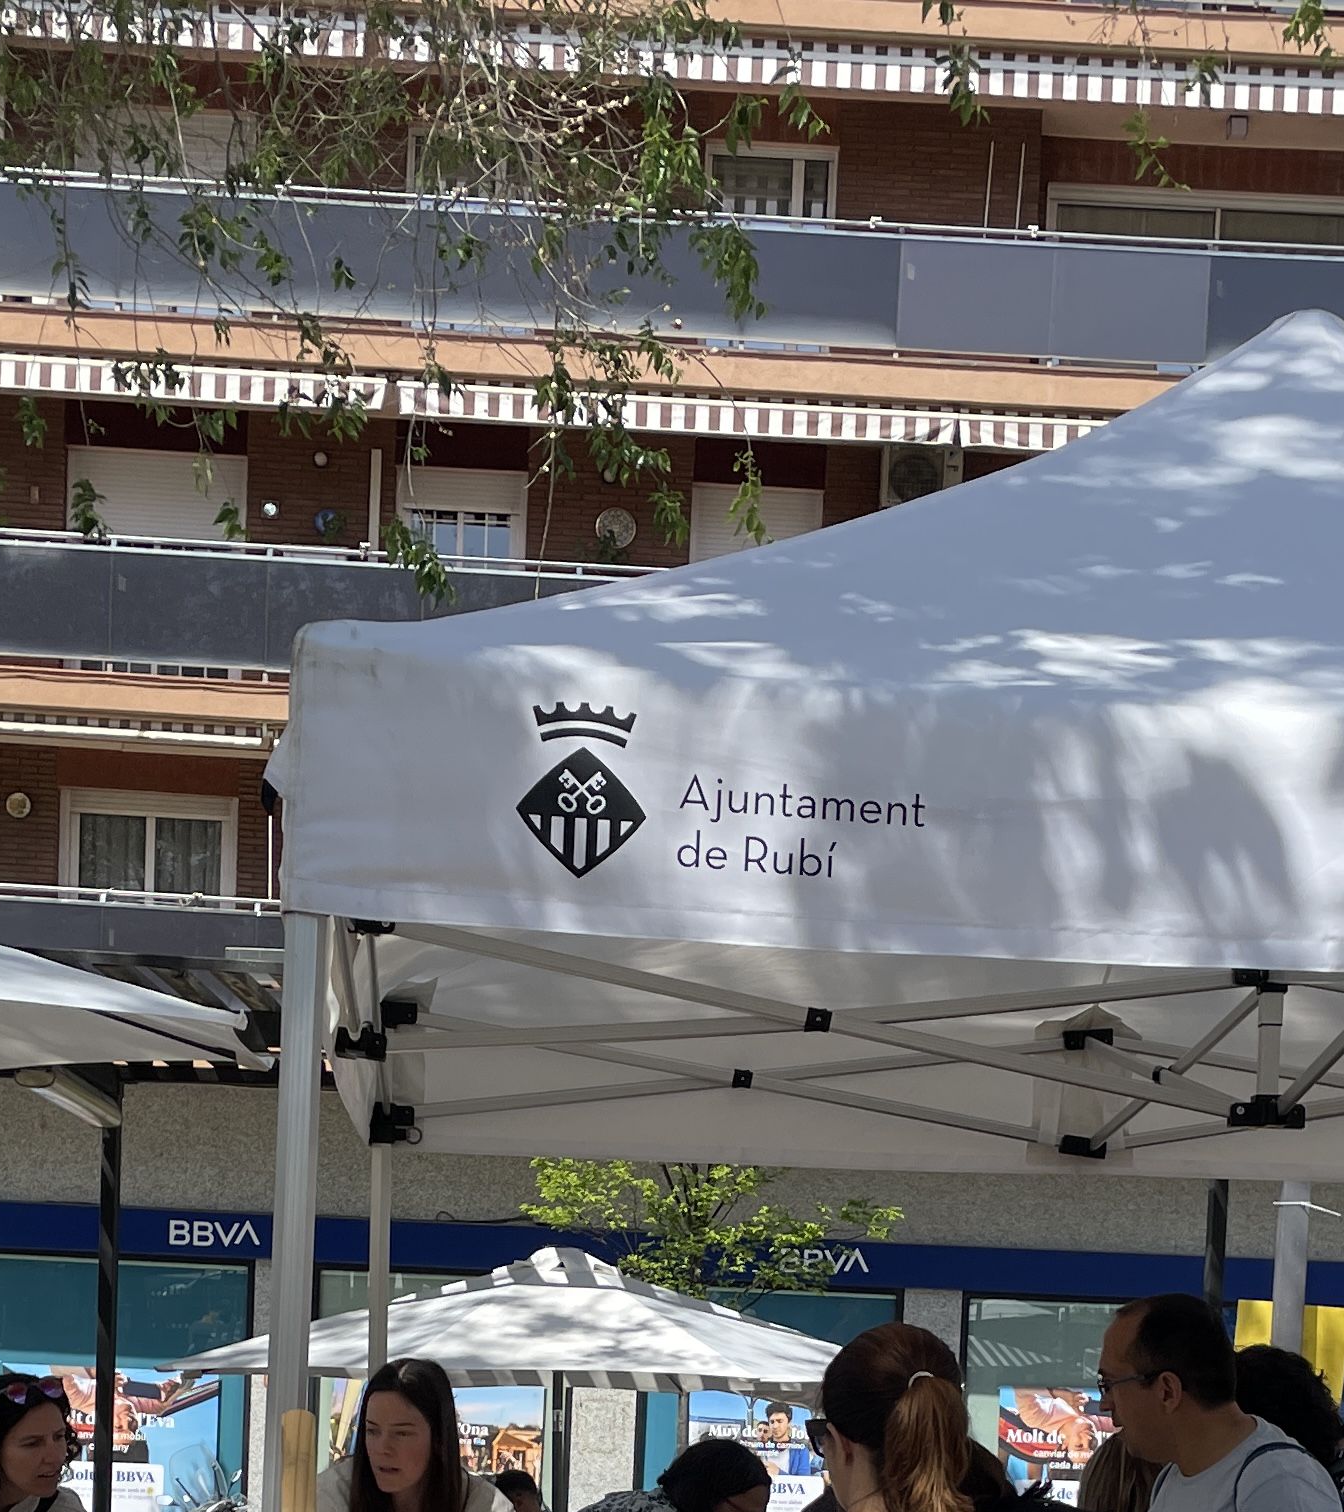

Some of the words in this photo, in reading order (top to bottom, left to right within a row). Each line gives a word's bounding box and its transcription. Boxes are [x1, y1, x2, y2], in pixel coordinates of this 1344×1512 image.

[679, 773, 926, 828] Ajuntament
[676, 829, 728, 870] de
[743, 835, 838, 878] Rubí
[168, 1219, 261, 1248] BBVA
[708, 1424, 741, 1438] Muy
[1006, 1429, 1045, 1444] Molt
[116, 1470, 155, 1483] BBVA
